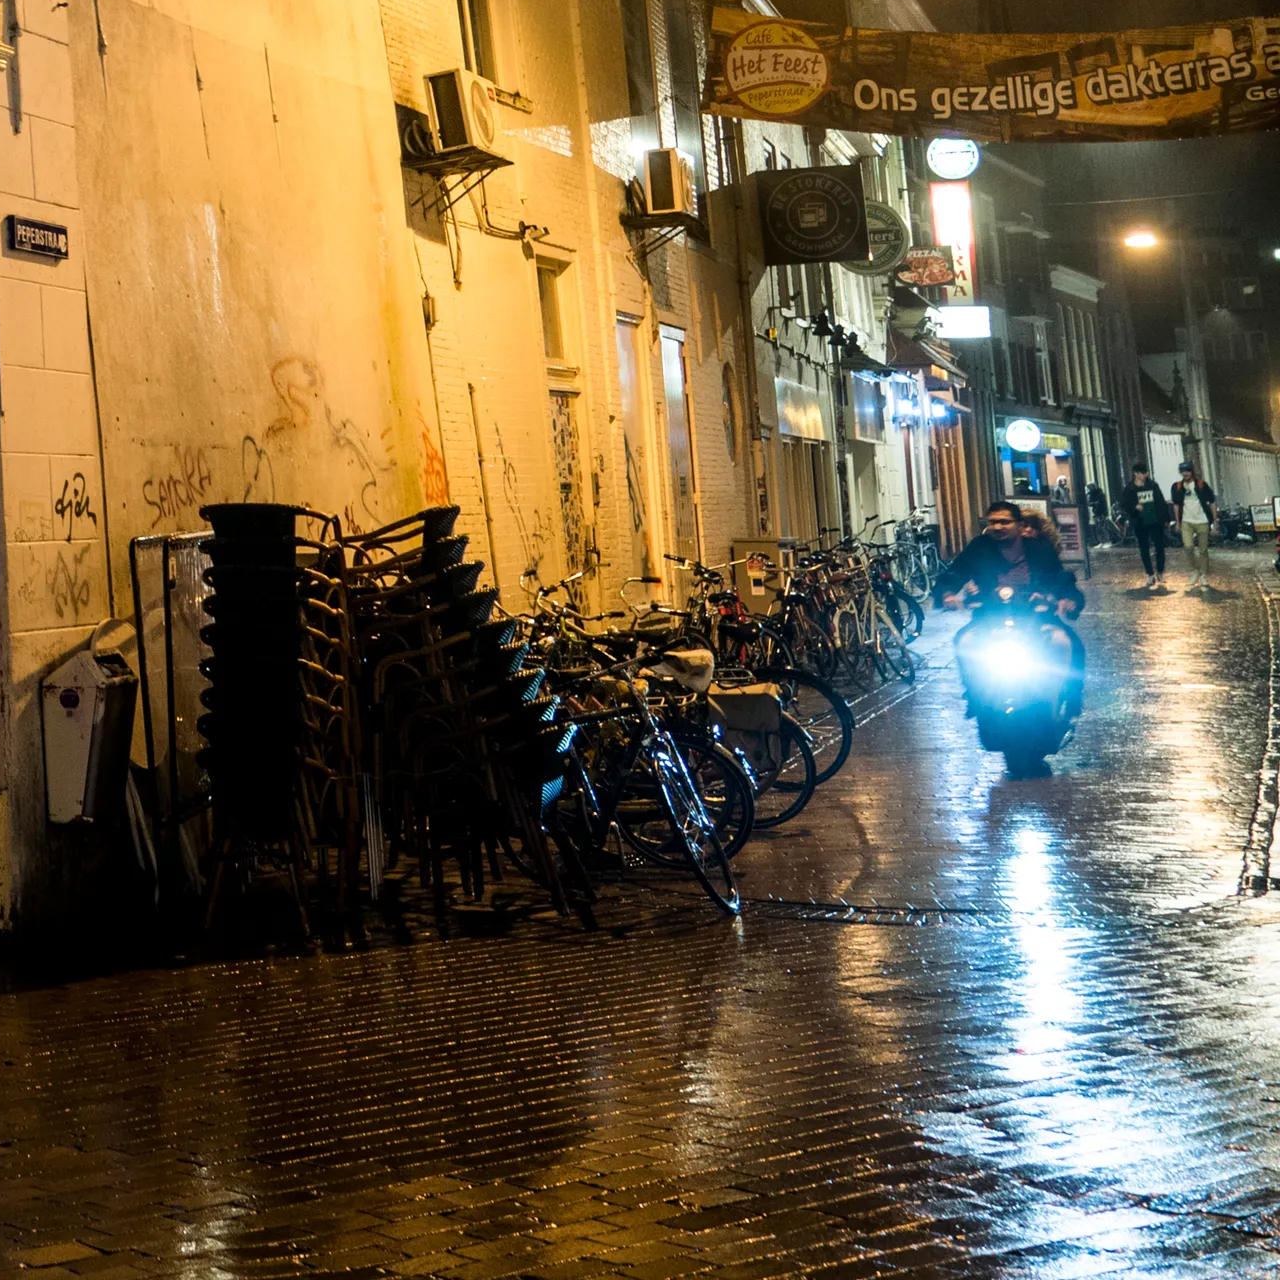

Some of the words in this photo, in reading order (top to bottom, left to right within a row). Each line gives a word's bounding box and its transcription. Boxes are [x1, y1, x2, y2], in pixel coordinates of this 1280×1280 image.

[745, 28, 775, 45] Café
[732, 54, 766, 80] Het
[772, 53, 822, 75] Feest
[853, 77, 918, 112] Ons
[931, 75, 1075, 120] gezellige
[1086, 50, 1252, 103] dakterras
[1246, 85, 1280, 102] Ge
